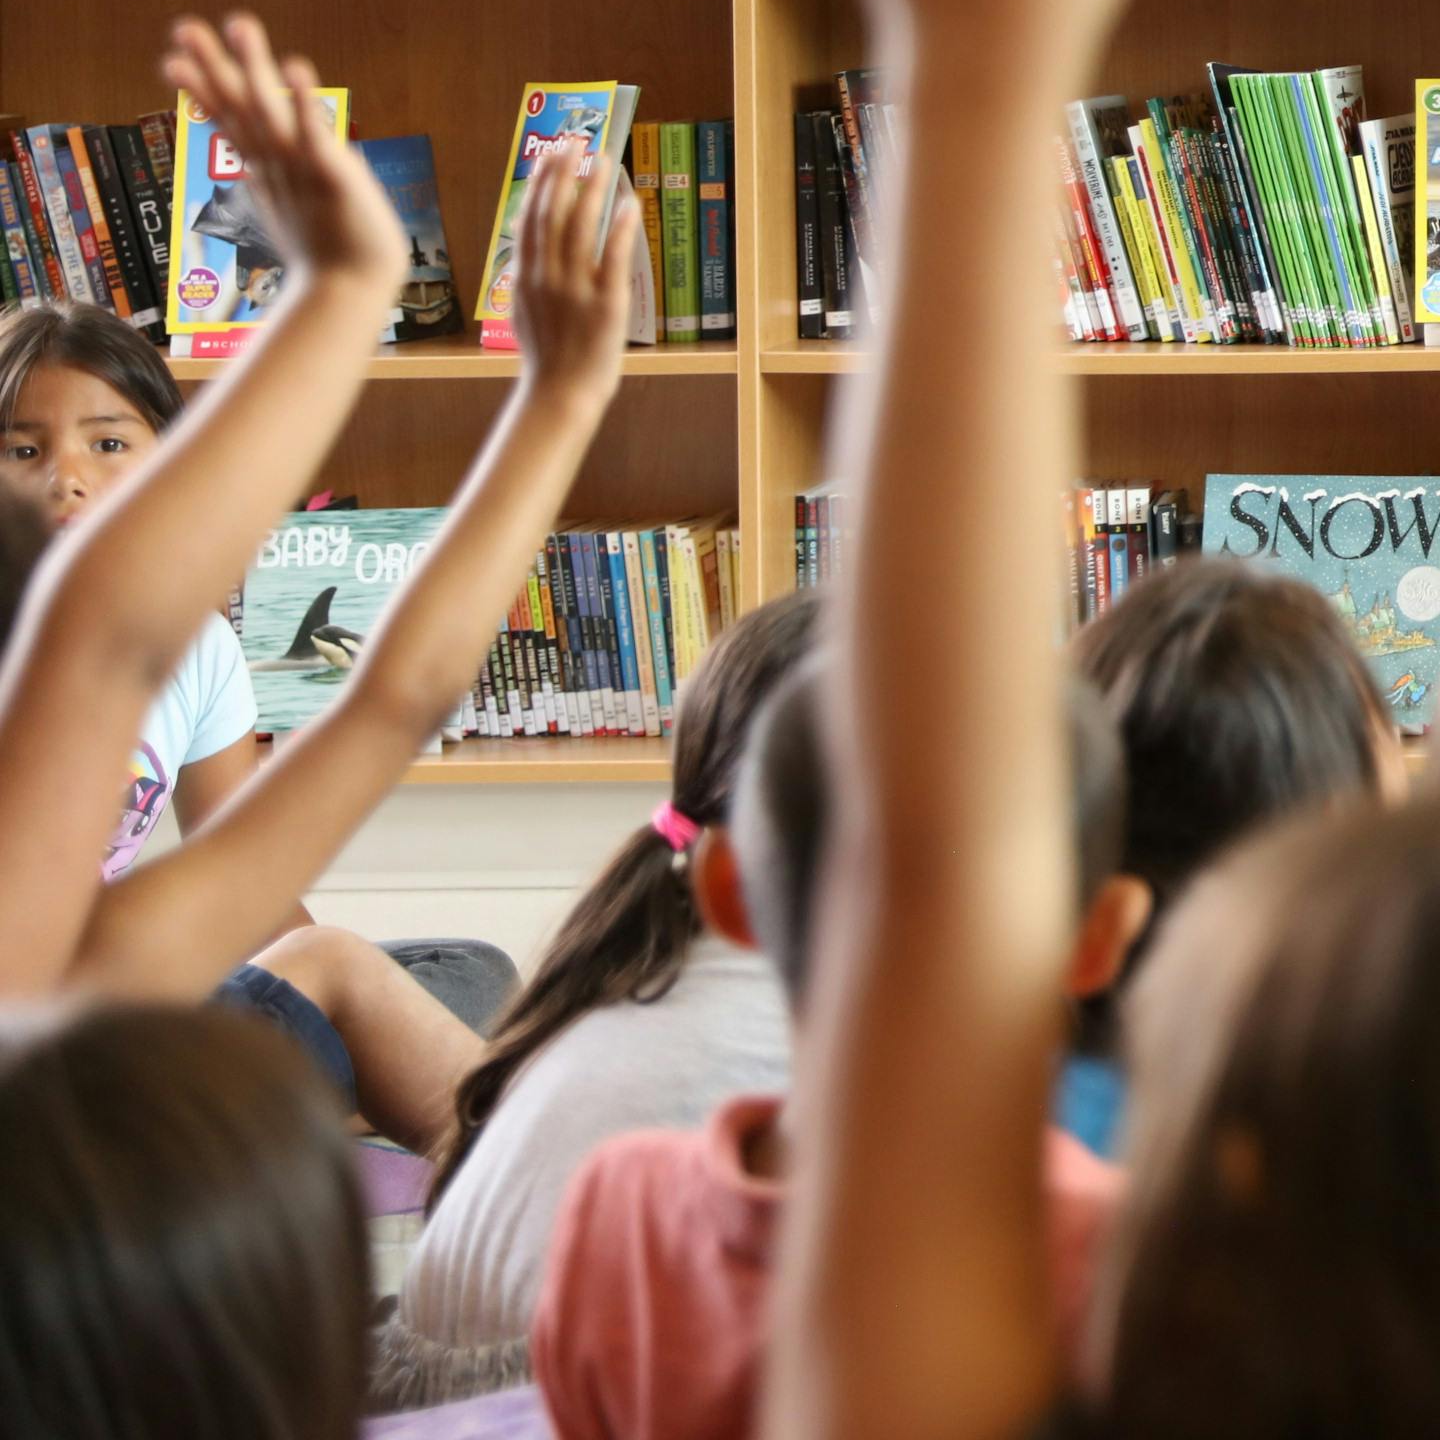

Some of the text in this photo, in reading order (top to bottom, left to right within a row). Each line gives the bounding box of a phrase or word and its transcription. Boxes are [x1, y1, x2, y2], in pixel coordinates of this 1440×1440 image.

[531, 96, 540, 111] 1
[19, 160, 38, 203] WALTERS
[650, 176, 657, 186] 2
[680, 176, 686, 186] 4
[1082, 159, 1104, 201] WOLVERINE
[139, 200, 168, 265] RULE
[64, 246, 89, 296] THE POL
[257, 524, 352, 570] BABY
[355, 542, 430, 584] ORC
[1087, 543, 1095, 588] AMULET
